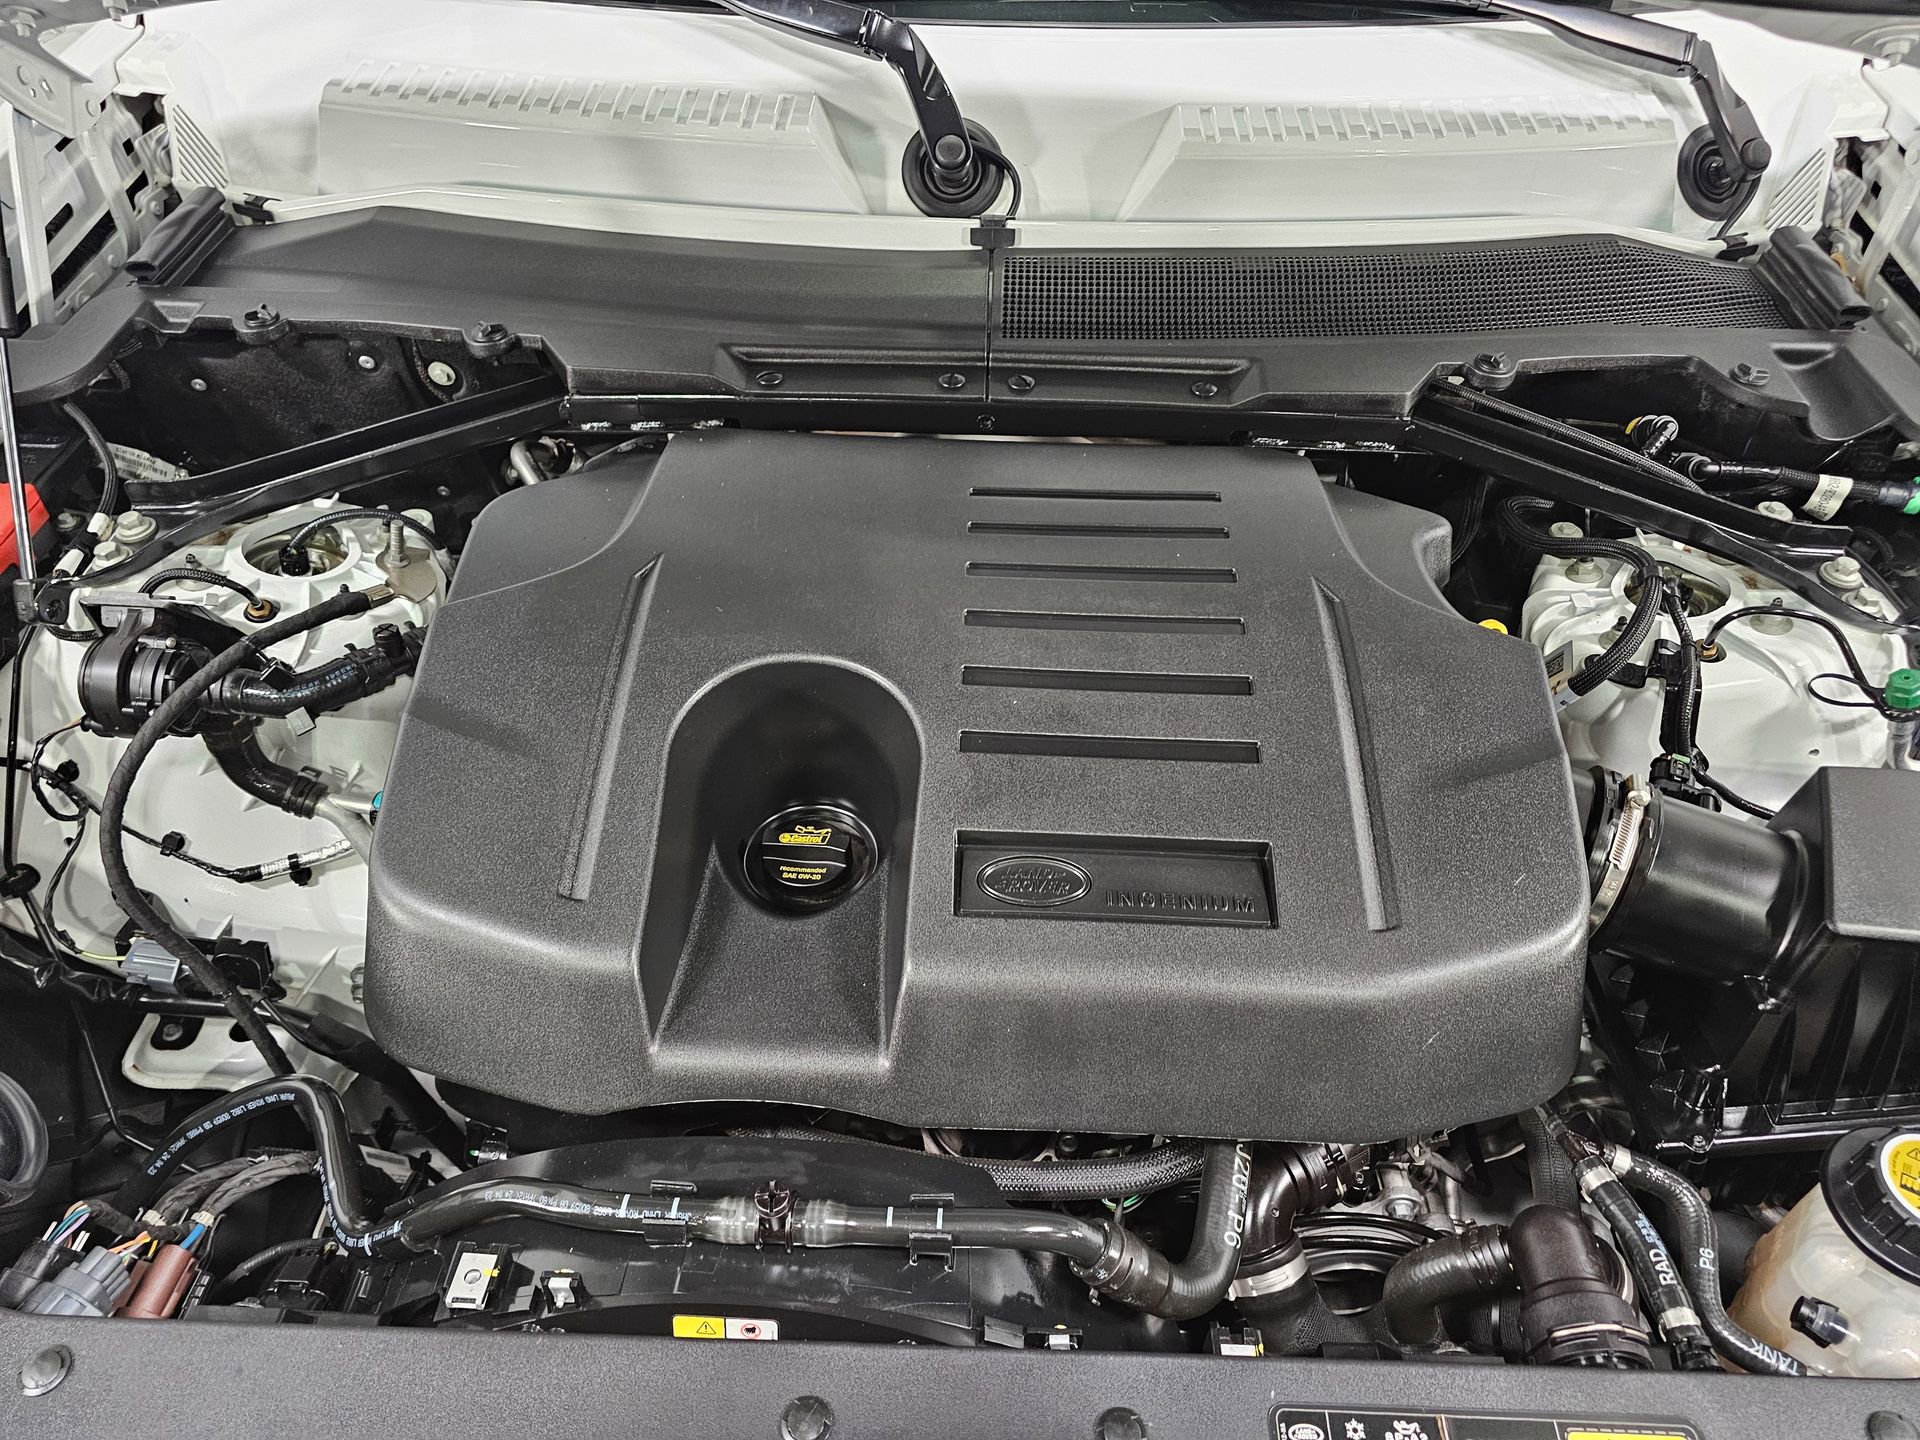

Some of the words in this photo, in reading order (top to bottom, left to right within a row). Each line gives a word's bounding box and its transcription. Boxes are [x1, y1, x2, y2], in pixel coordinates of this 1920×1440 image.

[790, 834, 822, 844] Castrol
[780, 866, 827, 874] recommended
[782, 872, 797, 880] SAE
[1001, 865, 1056, 880] LAND
[1003, 880, 1070, 895] ROVER
[1105, 890, 1256, 914] INGENIUM
[1699, 1247, 1714, 1271] P6
[1649, 1248, 1678, 1286] RAD
[1751, 1337, 1800, 1376] TANK
